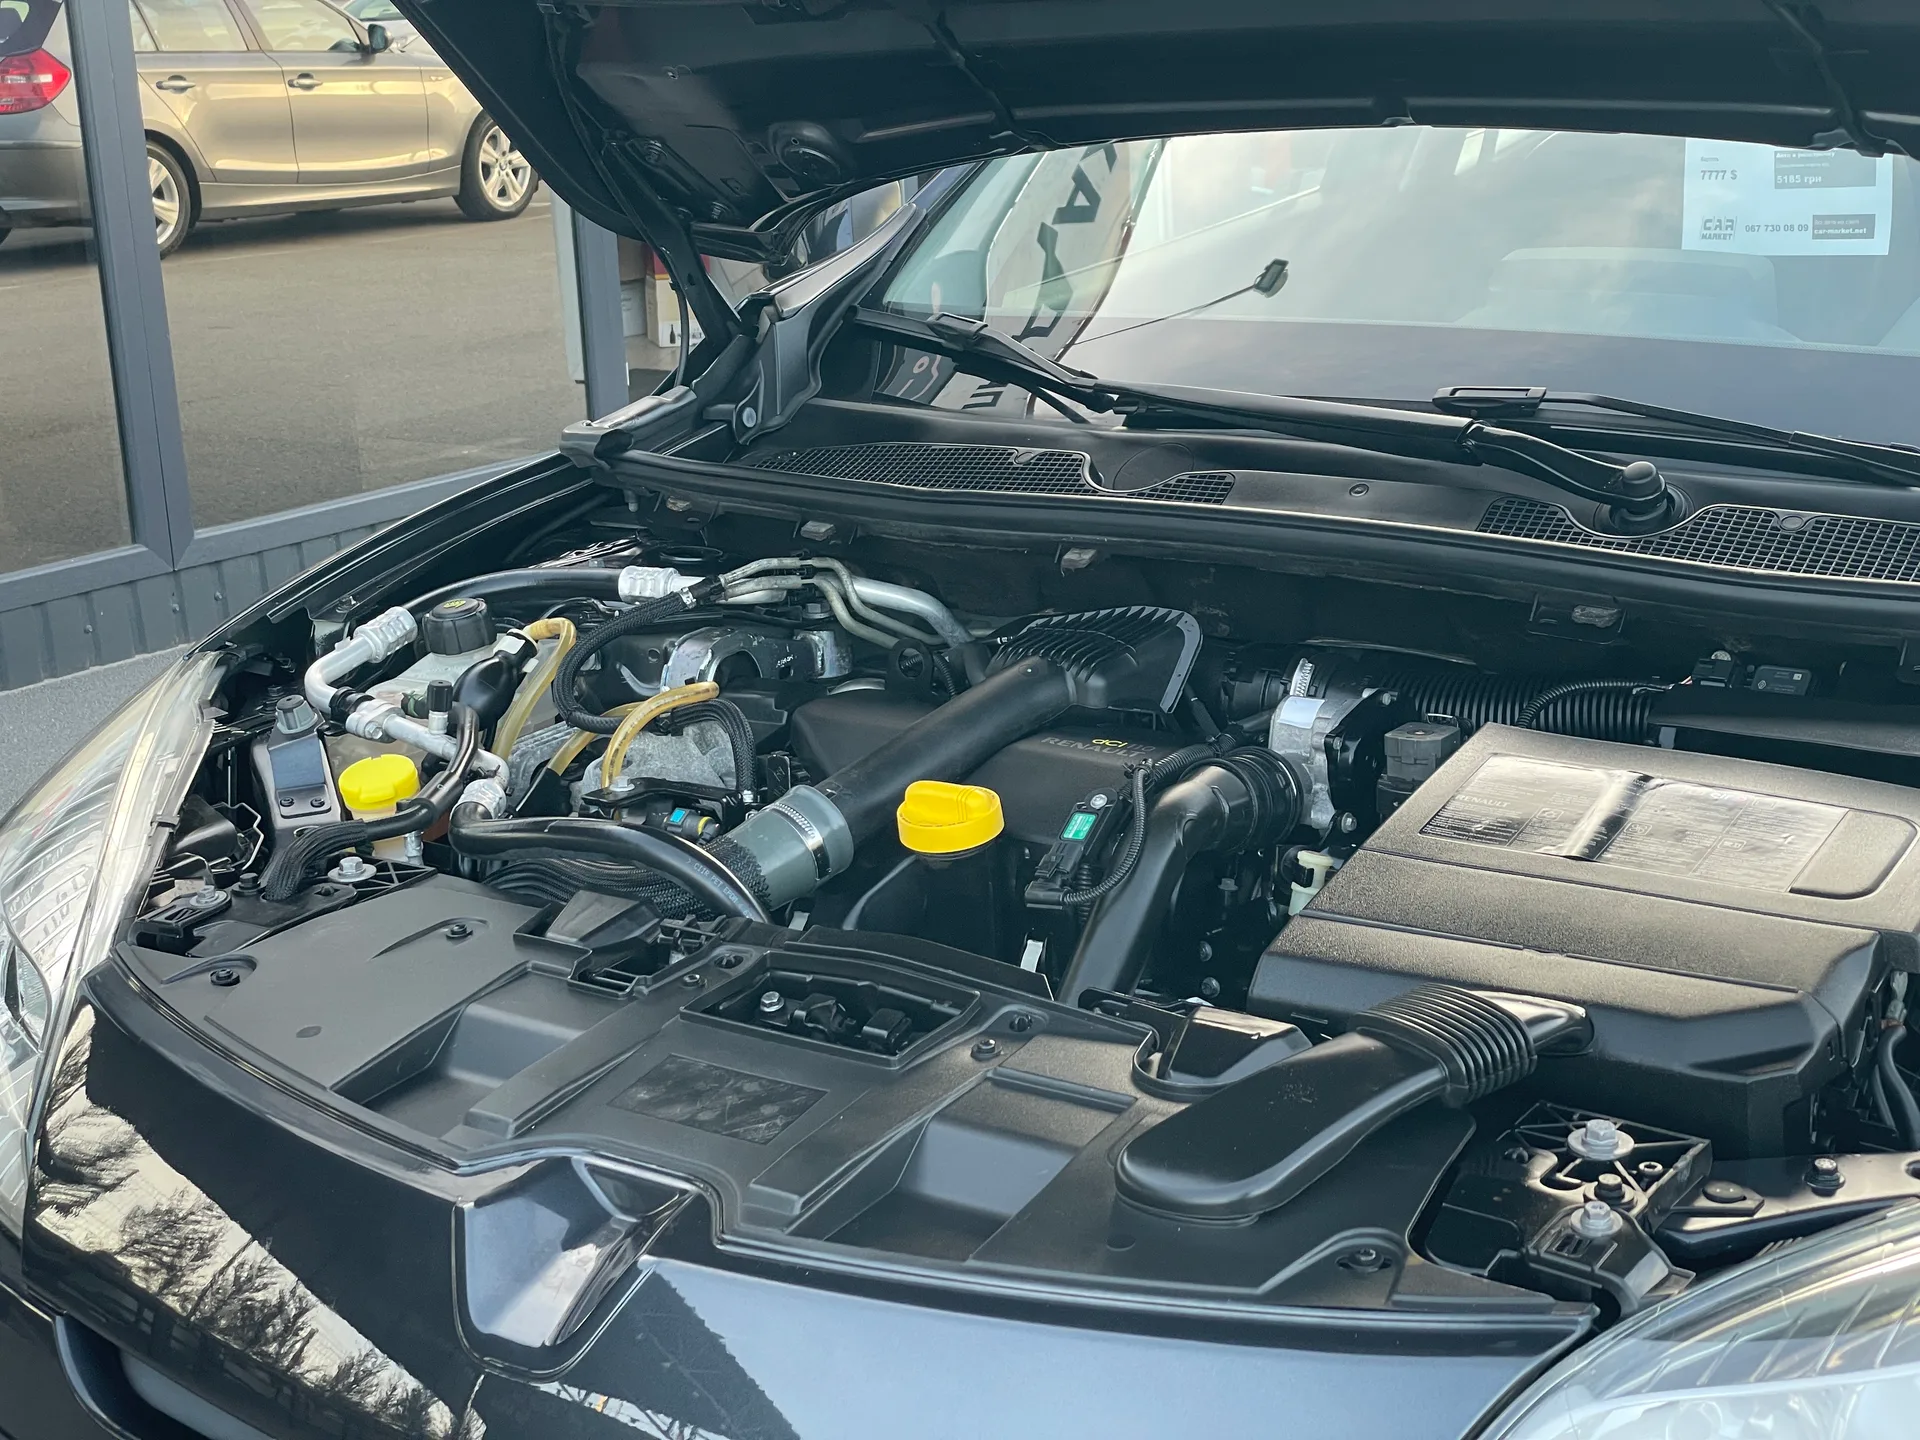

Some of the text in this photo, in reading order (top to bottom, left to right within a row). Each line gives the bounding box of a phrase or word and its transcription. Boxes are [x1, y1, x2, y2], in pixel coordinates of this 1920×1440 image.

[1701, 170, 1738, 180] 7777 $
[1703, 218, 1734, 231] CAR
[1745, 223, 1809, 233] 067 730 08 09
[1701, 233, 1733, 241] MARKET
[1040, 736, 1146, 758] RENAULT
[1454, 794, 1511, 808] RENAULT
